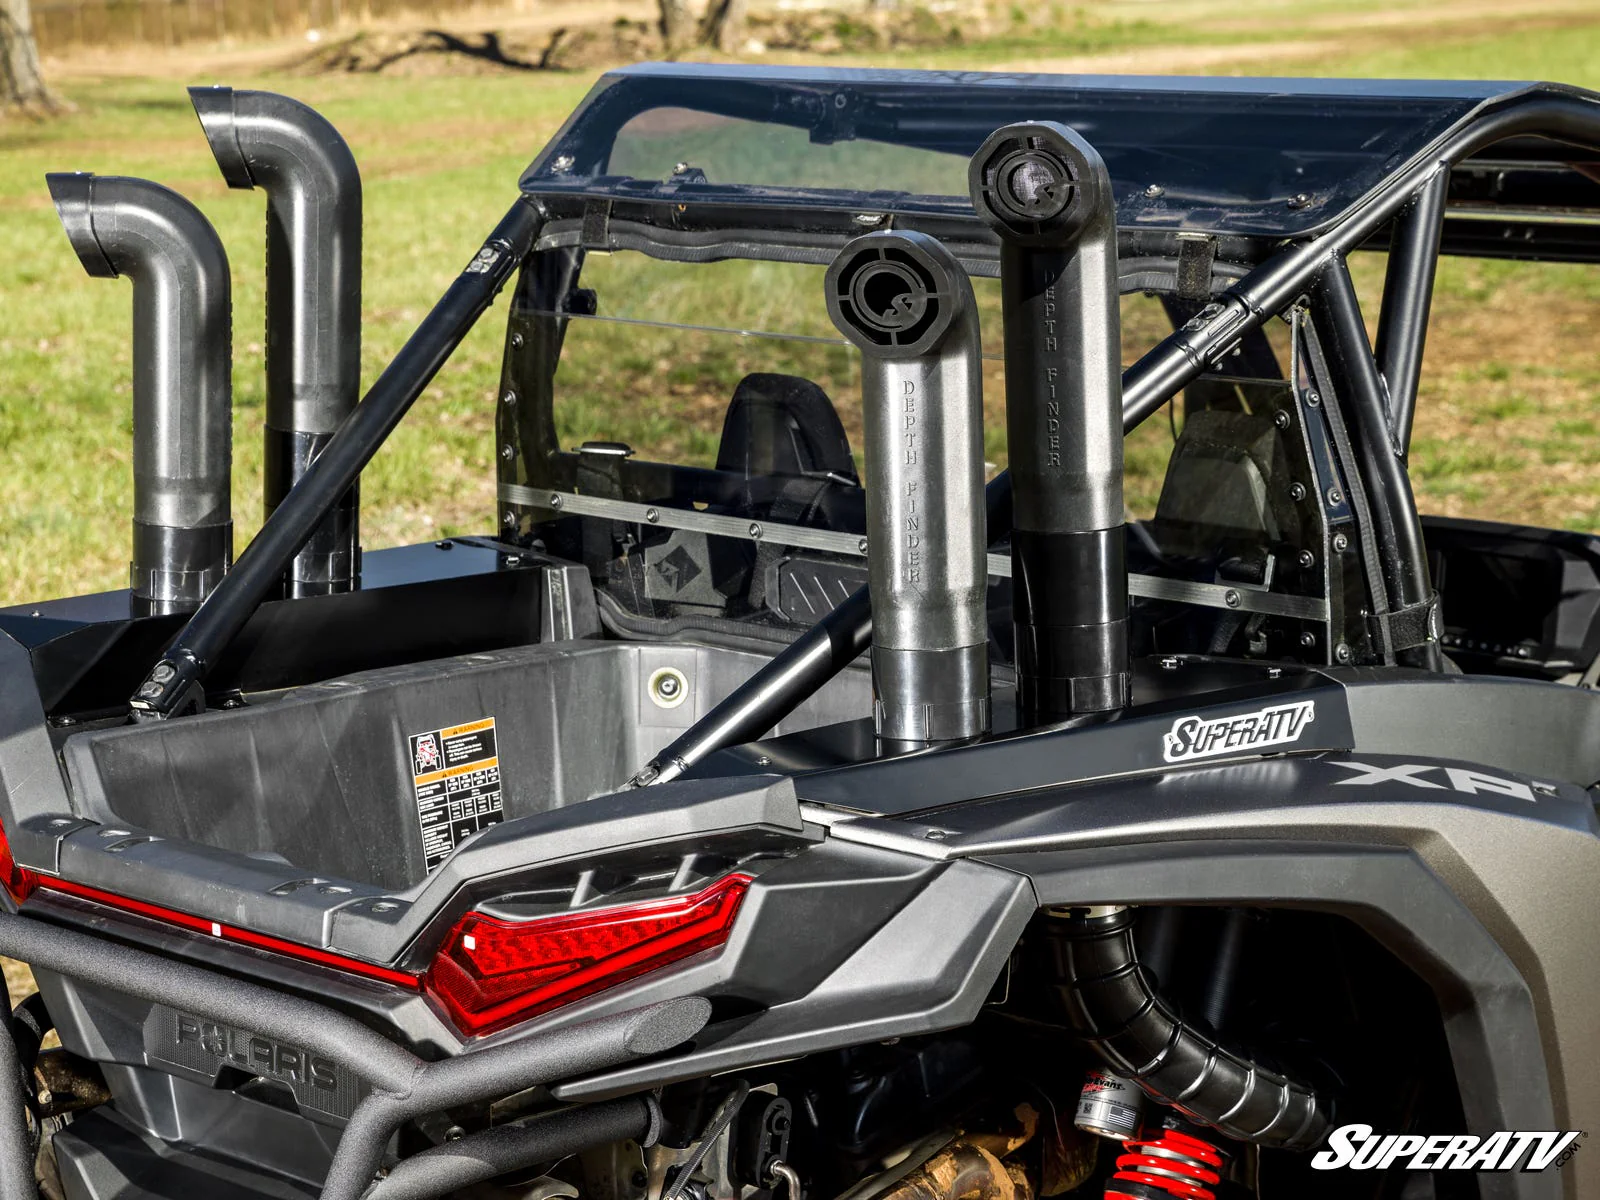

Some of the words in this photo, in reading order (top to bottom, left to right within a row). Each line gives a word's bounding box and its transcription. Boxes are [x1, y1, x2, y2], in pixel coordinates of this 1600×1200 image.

[1044, 269, 1057, 351] DEPTH
[903, 380, 917, 465] DEPTH
[1046, 367, 1061, 467] FINDER
[906, 482, 920, 583] FINDER
[176, 1014, 338, 1092] POLARIS
